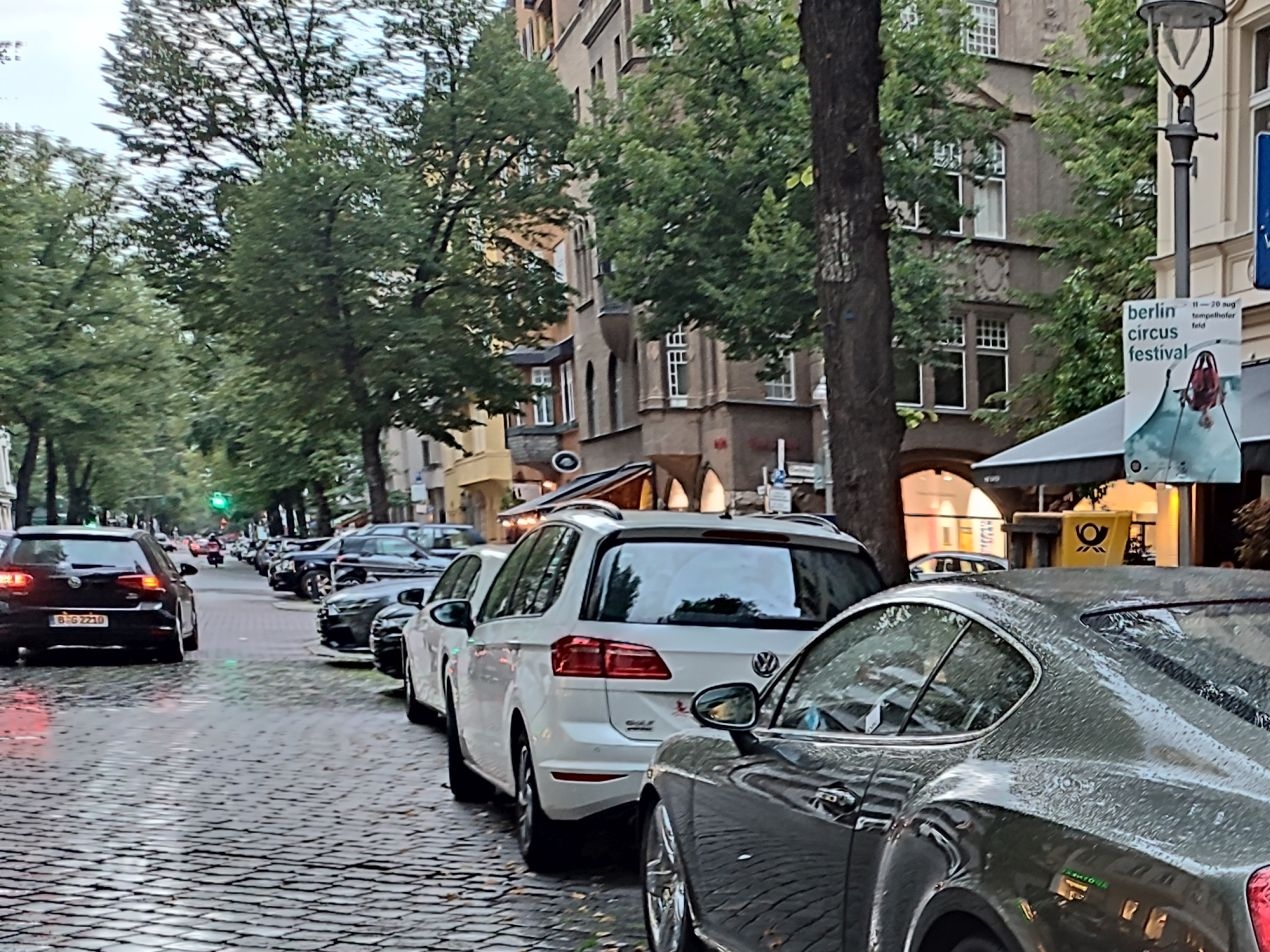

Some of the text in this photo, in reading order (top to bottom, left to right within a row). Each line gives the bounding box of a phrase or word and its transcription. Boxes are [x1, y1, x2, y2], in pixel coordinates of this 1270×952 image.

[1128, 303, 1175, 320] berlin
[1128, 325, 1178, 341] circus
[1129, 343, 1188, 362] festival
